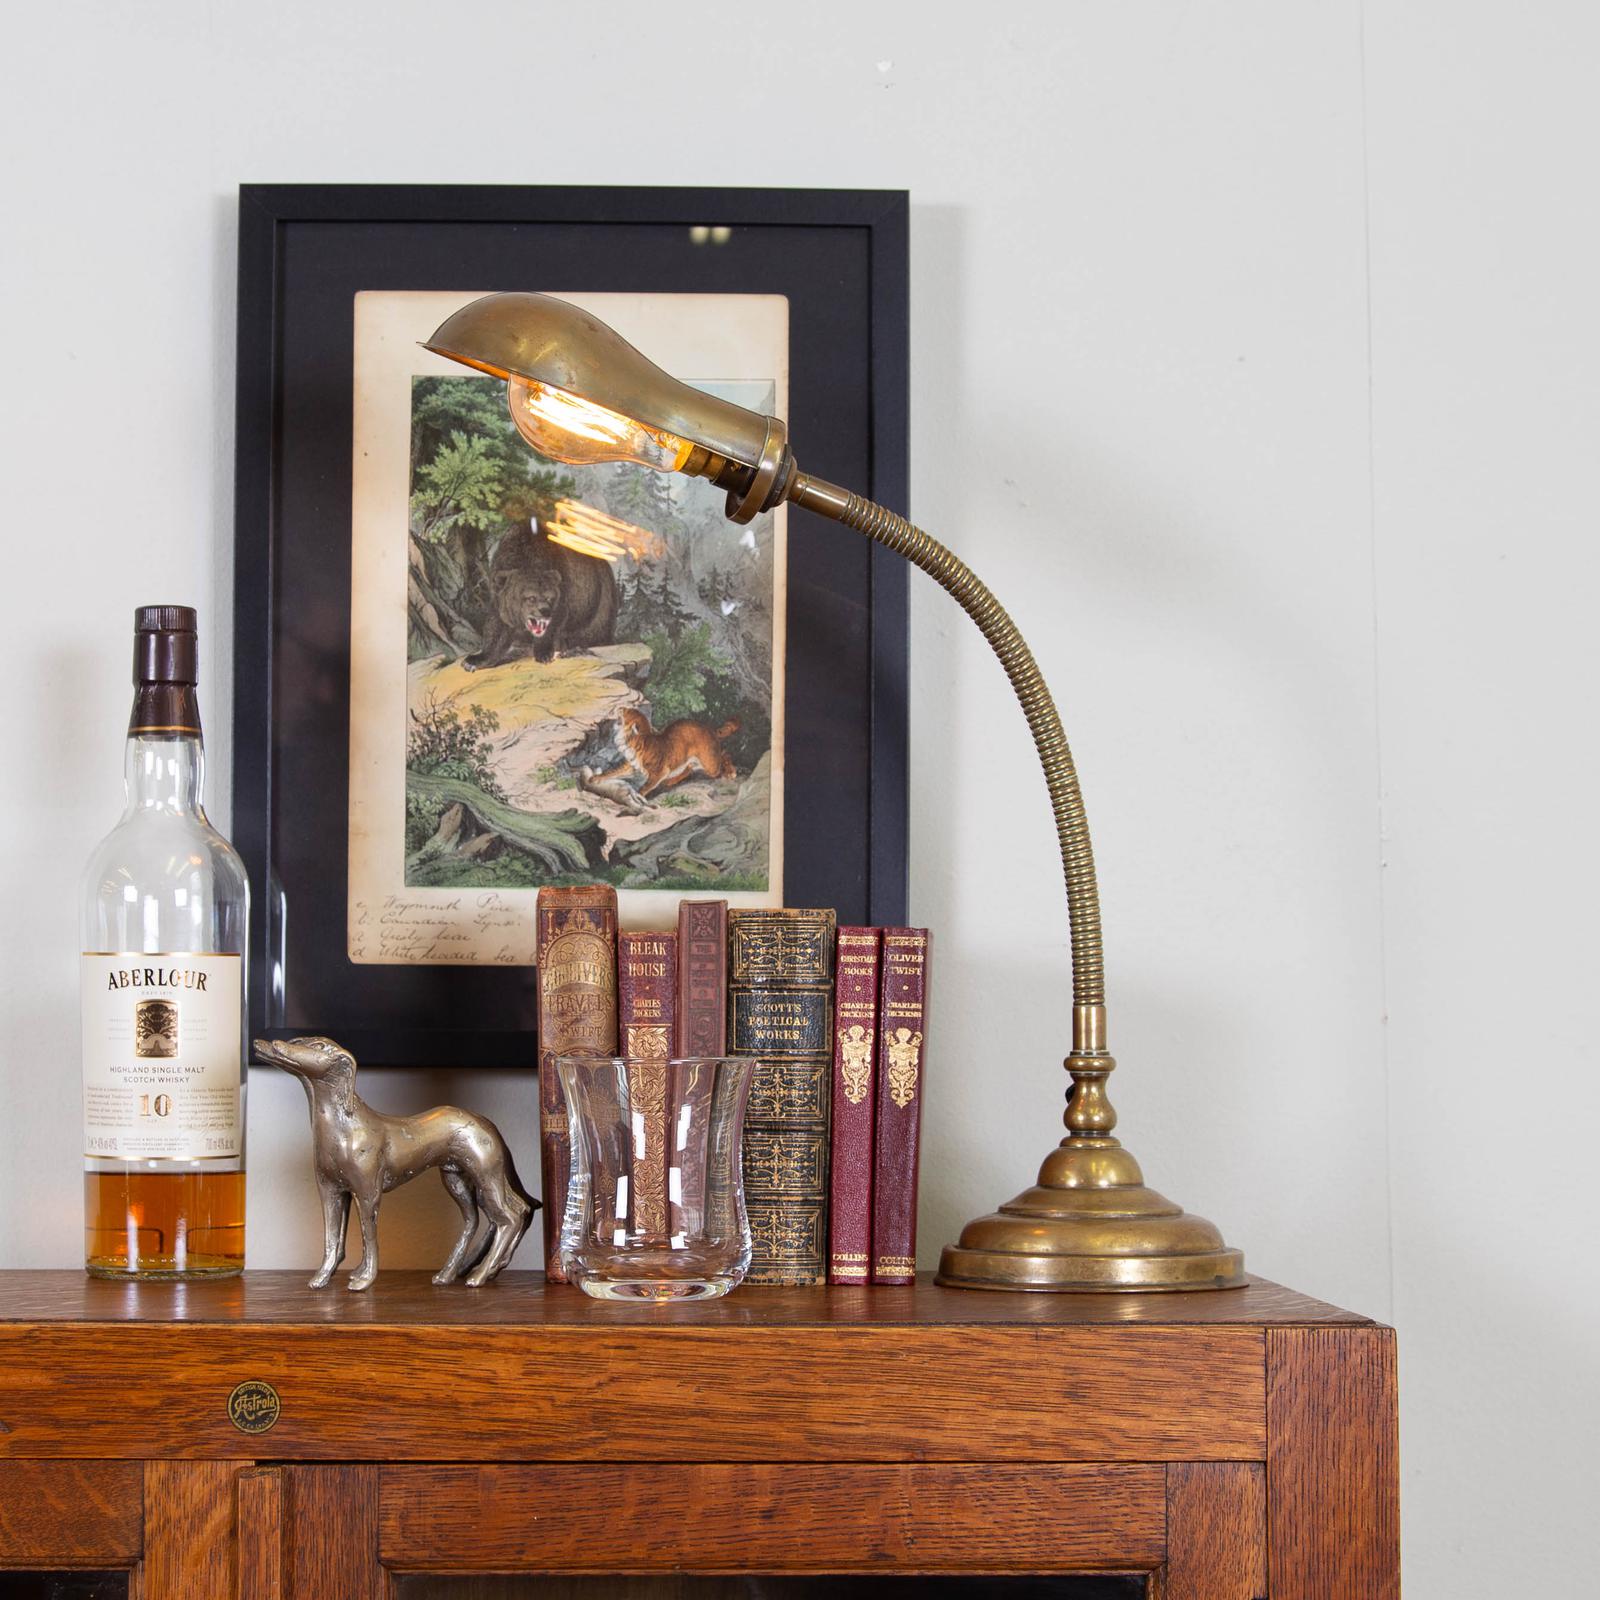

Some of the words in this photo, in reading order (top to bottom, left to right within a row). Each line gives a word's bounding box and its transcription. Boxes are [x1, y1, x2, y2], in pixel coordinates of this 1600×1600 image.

[630, 942, 667, 955] BLEAK
[889, 954, 924, 962] OLIVER
[628, 962, 666, 977] HOUSE
[844, 967, 873, 975] BOOKS
[891, 966, 921, 975] TWIST
[108, 968, 208, 992] ABERLOUR
[545, 992, 613, 1012] TRAVELS
[632, 999, 661, 1007] CHARLES
[632, 1009, 662, 1018] DICKENS
[887, 1010, 922, 1018] DICKENS
[748, 1015, 810, 1026] POETICAL
[110, 1066, 149, 1074] HIGHLAND
[152, 1066, 182, 1074] SINGLE
[185, 1066, 205, 1074] MALT
[124, 1076, 156, 1084] SCOTCH
[158, 1076, 190, 1084] WHISKY
[139, 1093, 174, 1118] 10
[833, 1253, 868, 1262] COLLINS
